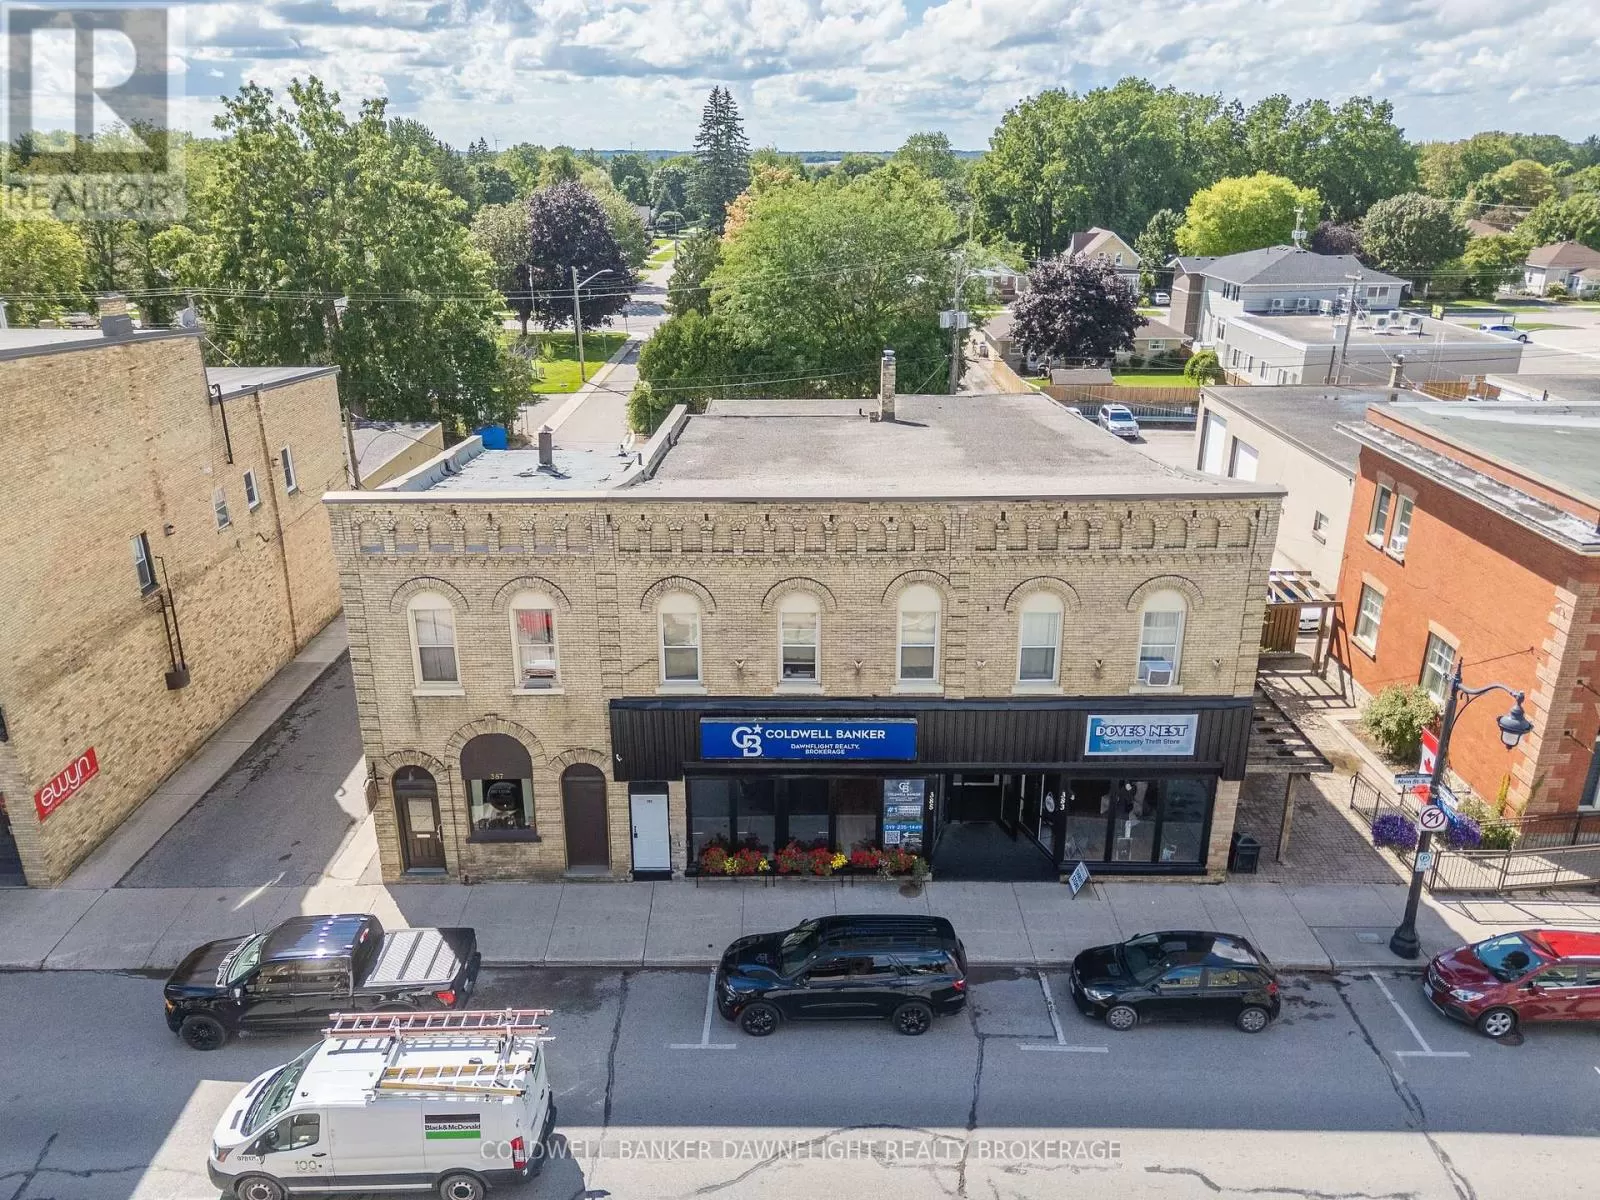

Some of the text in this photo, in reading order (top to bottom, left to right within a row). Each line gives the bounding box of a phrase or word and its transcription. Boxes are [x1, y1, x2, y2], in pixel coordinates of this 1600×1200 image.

[765, 729, 886, 739] COLDWELL BANKER
[1095, 725, 1188, 737] DOVE'S NEST
[1107, 738, 1143, 746] Community
[41, 756, 91, 807] ewyn
